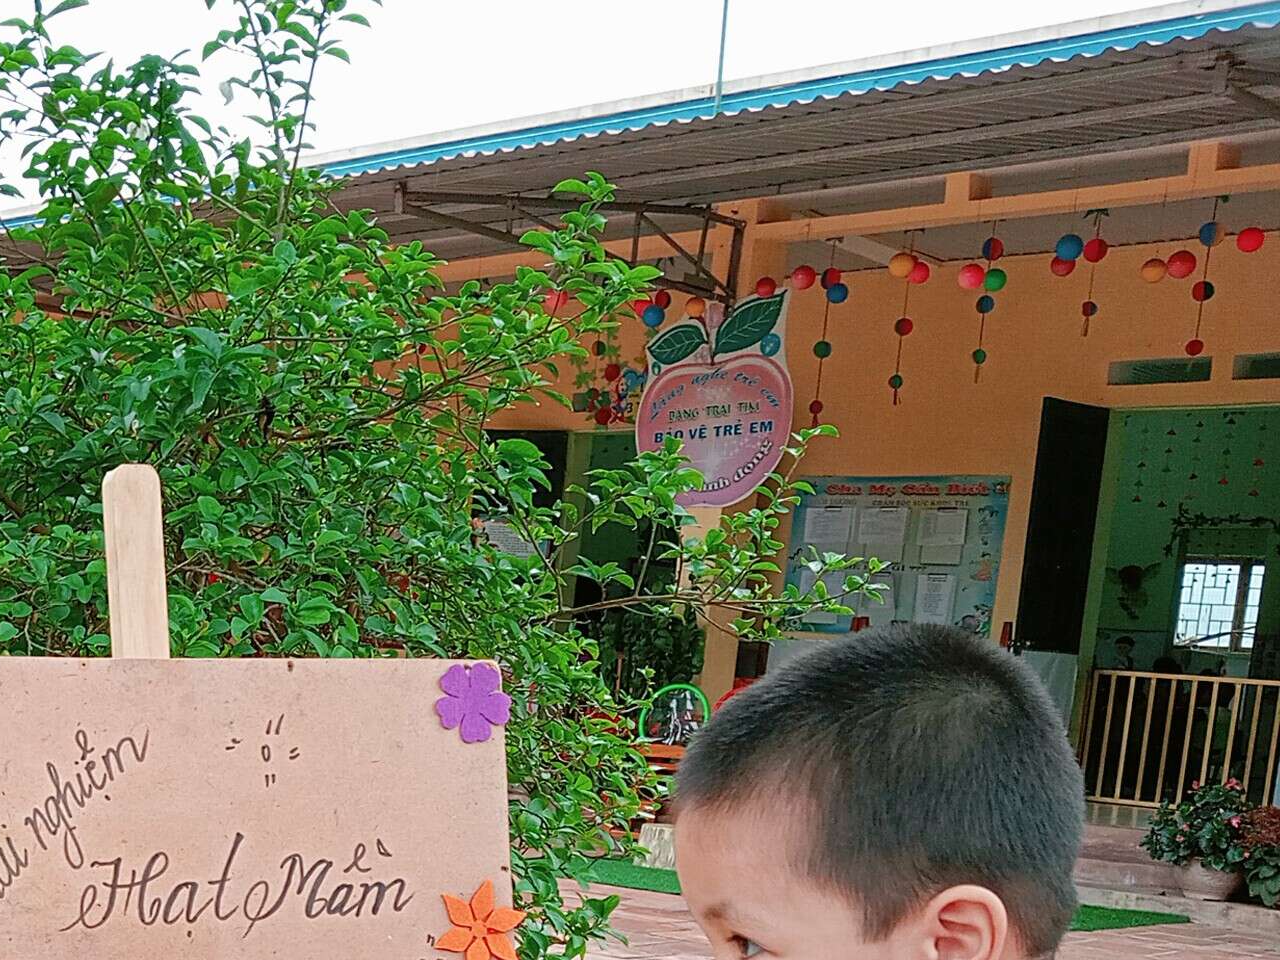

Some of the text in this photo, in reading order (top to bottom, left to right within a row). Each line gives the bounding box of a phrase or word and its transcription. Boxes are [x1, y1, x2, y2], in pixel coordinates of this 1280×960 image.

[714, 419, 743, 438] TRẺ
[749, 420, 774, 434] EM
[737, 401, 761, 414] TIM
[23, 729, 150, 870] nghiệm
[59, 832, 244, 938] Hạt
